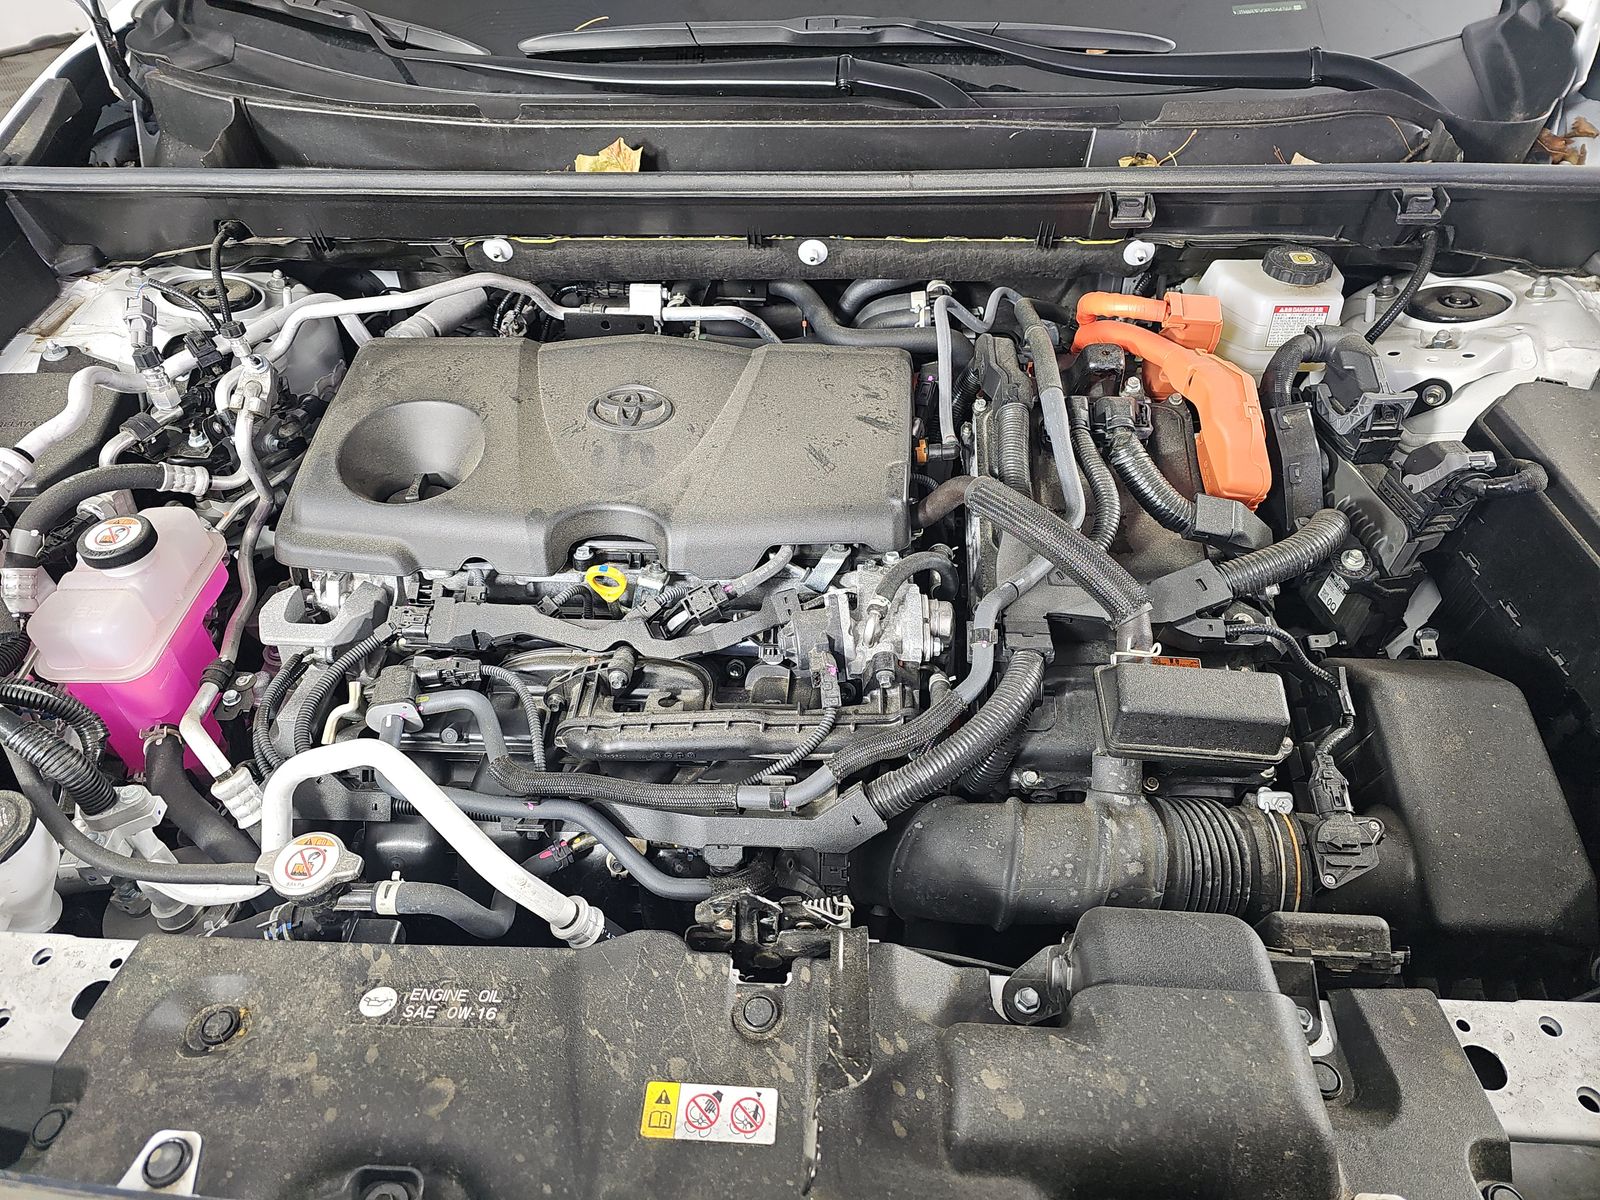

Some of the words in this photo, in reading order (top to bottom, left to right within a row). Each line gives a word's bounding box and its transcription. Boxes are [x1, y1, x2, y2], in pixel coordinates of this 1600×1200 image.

[410, 988, 469, 1002] ENGINE
[478, 989, 502, 1003] OIL
[402, 1005, 438, 1019] SAE
